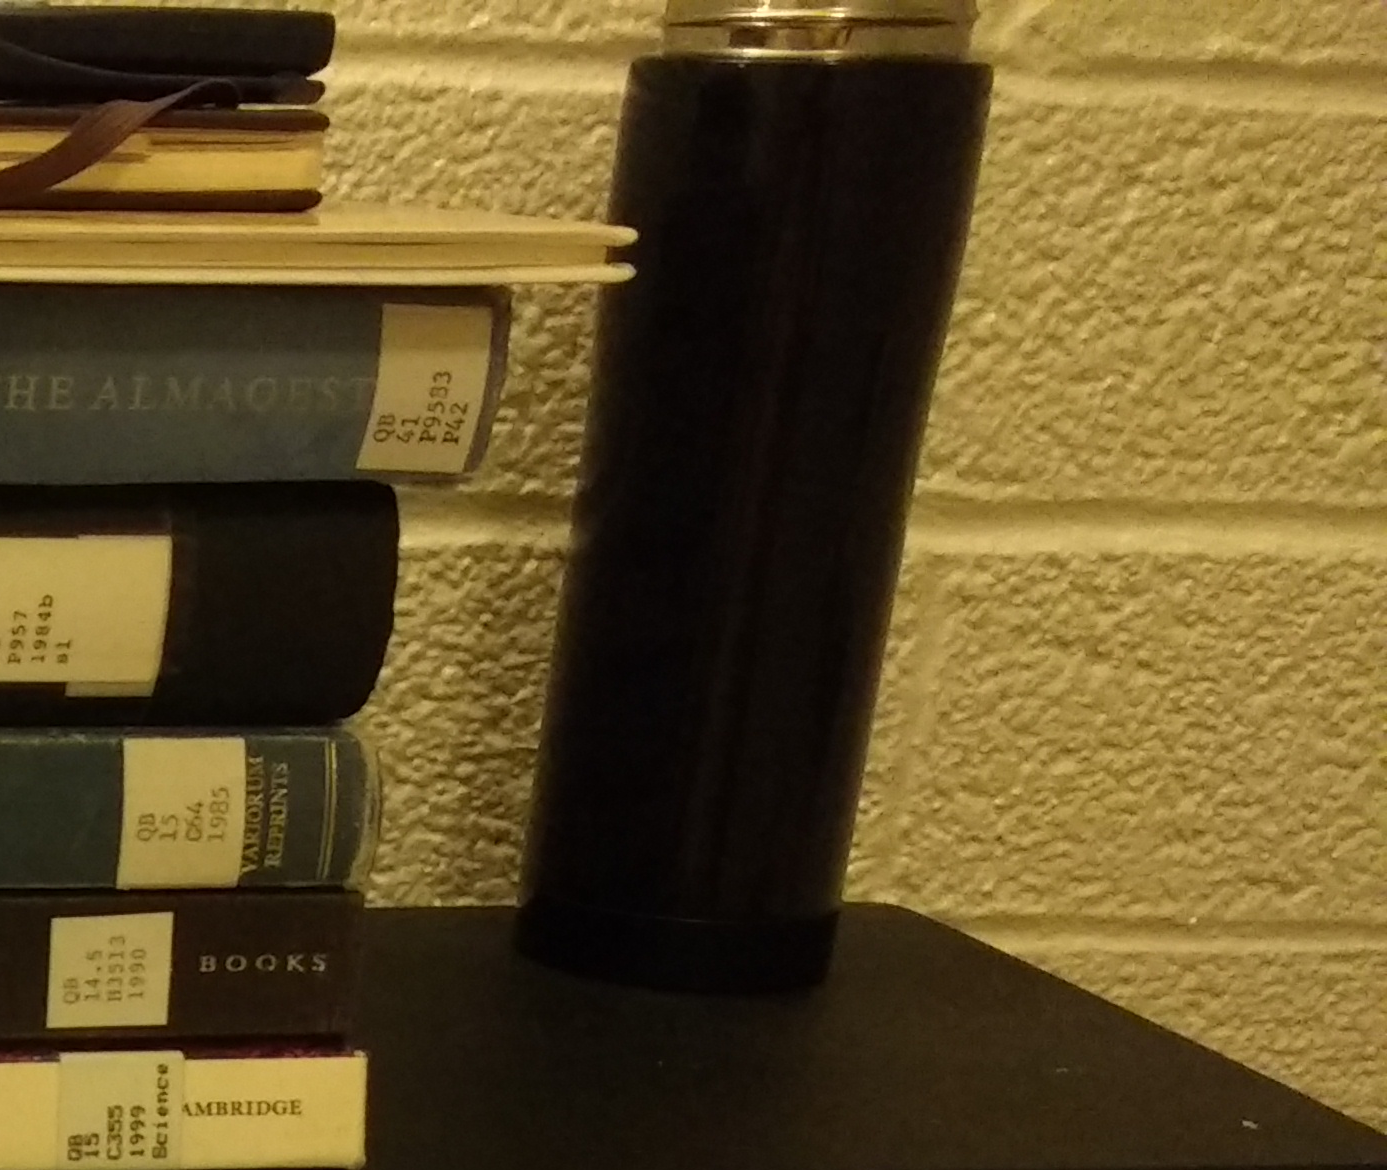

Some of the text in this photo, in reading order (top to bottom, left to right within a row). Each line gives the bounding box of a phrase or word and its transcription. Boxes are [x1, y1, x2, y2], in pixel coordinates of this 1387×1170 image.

[88, 375, 375, 412] ALMAGEST
[373, 414, 395, 443] QB
[7, 610, 28, 664] P957
[137, 812, 158, 841] QB
[159, 814, 178, 841] 15
[207, 787, 230, 842] 1985
[240, 756, 265, 875] VARIORUM
[264, 762, 289, 868] REPRINTS
[128, 949, 147, 1000] 1990
[199, 954, 327, 973] BOOKS
[107, 1105, 123, 1160] C355
[129, 1105, 146, 1157] 1999
[152, 1063, 169, 1159] Science
[182, 1098, 303, 1118] AMBRIDGE
